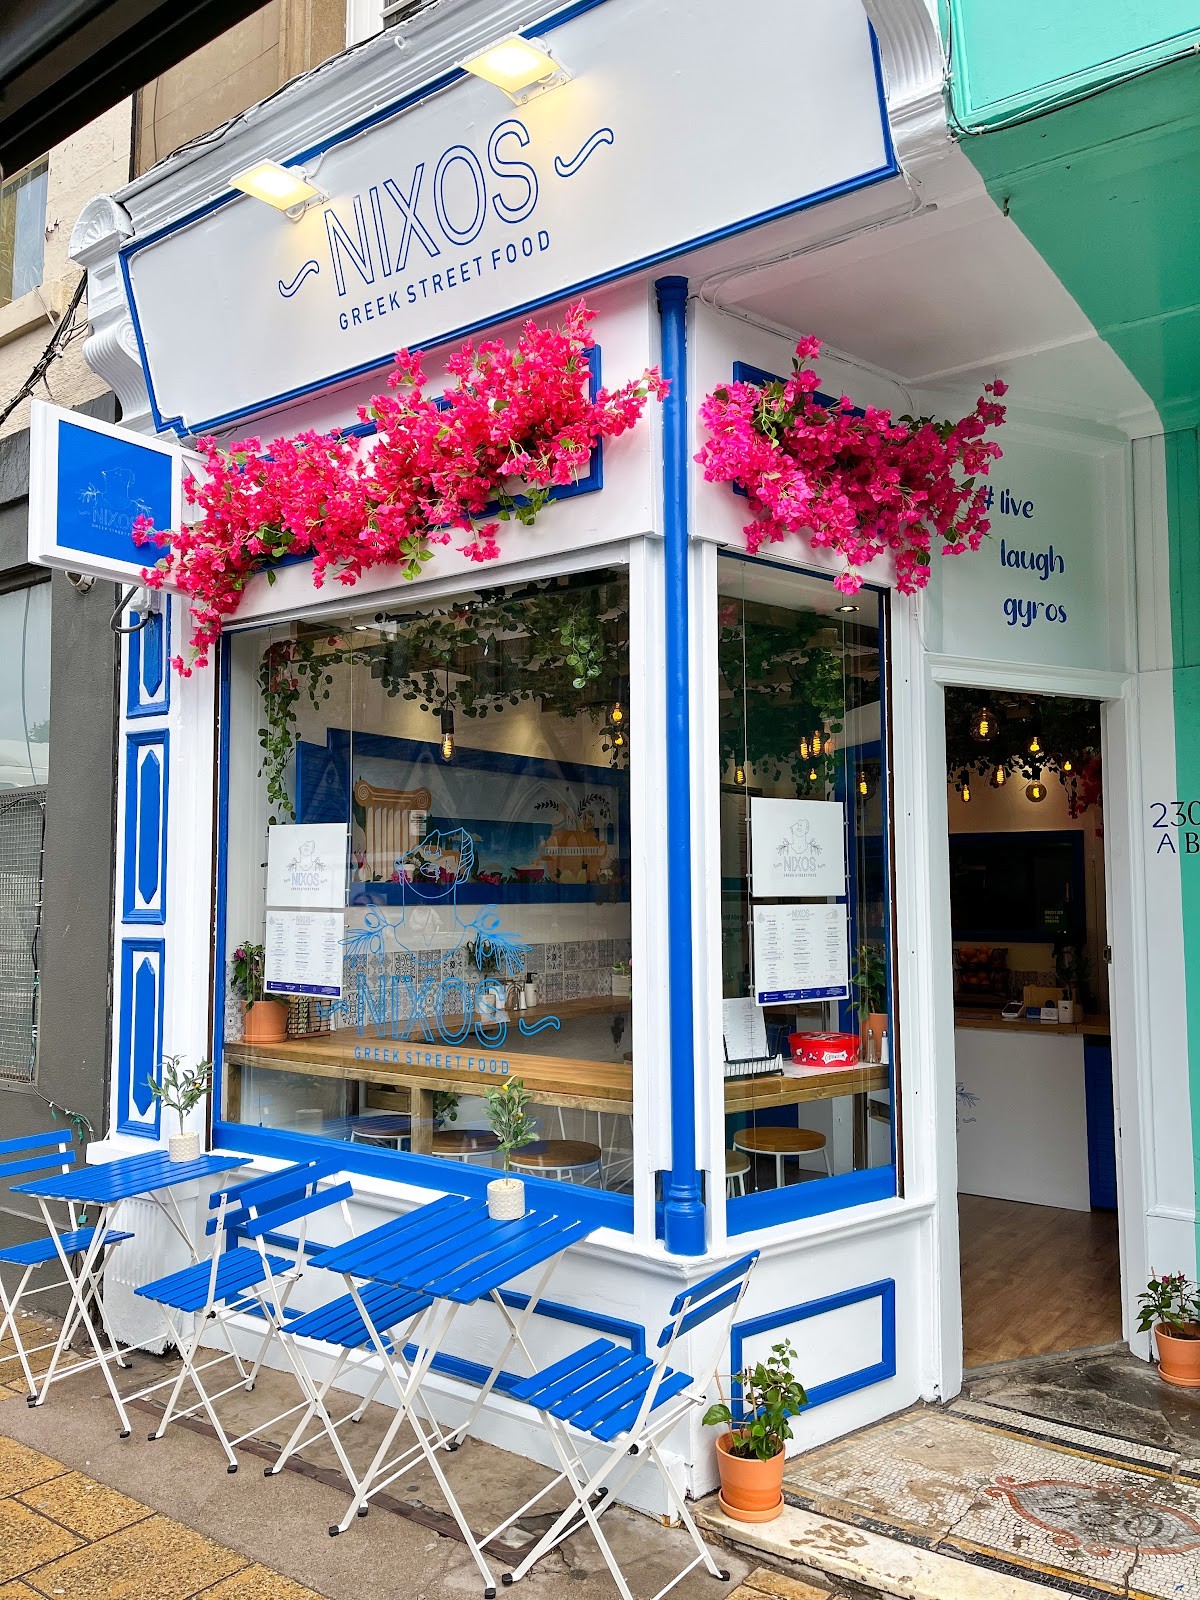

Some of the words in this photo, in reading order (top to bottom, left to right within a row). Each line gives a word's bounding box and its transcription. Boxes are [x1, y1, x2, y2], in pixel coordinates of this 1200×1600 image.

[324, 119, 539, 296] NIXOS
[339, 290, 402, 330] GREEK
[407, 256, 483, 304] STREET
[492, 229, 551, 270] FOOD
[1000, 488, 1034, 518] live
[1000, 538, 1065, 581] laugh
[1003, 598, 1067, 628] gyros
[1149, 800, 1200, 828] 230
[1157, 832, 1176, 854] A
[784, 856, 816, 872] NIXOS
[291, 872, 320, 887] NIXOS
[357, 972, 508, 1049] NIXOS
[354, 1046, 400, 1063] GREEK
[405, 1051, 461, 1070] STREET
[467, 1056, 510, 1075] FOOD
